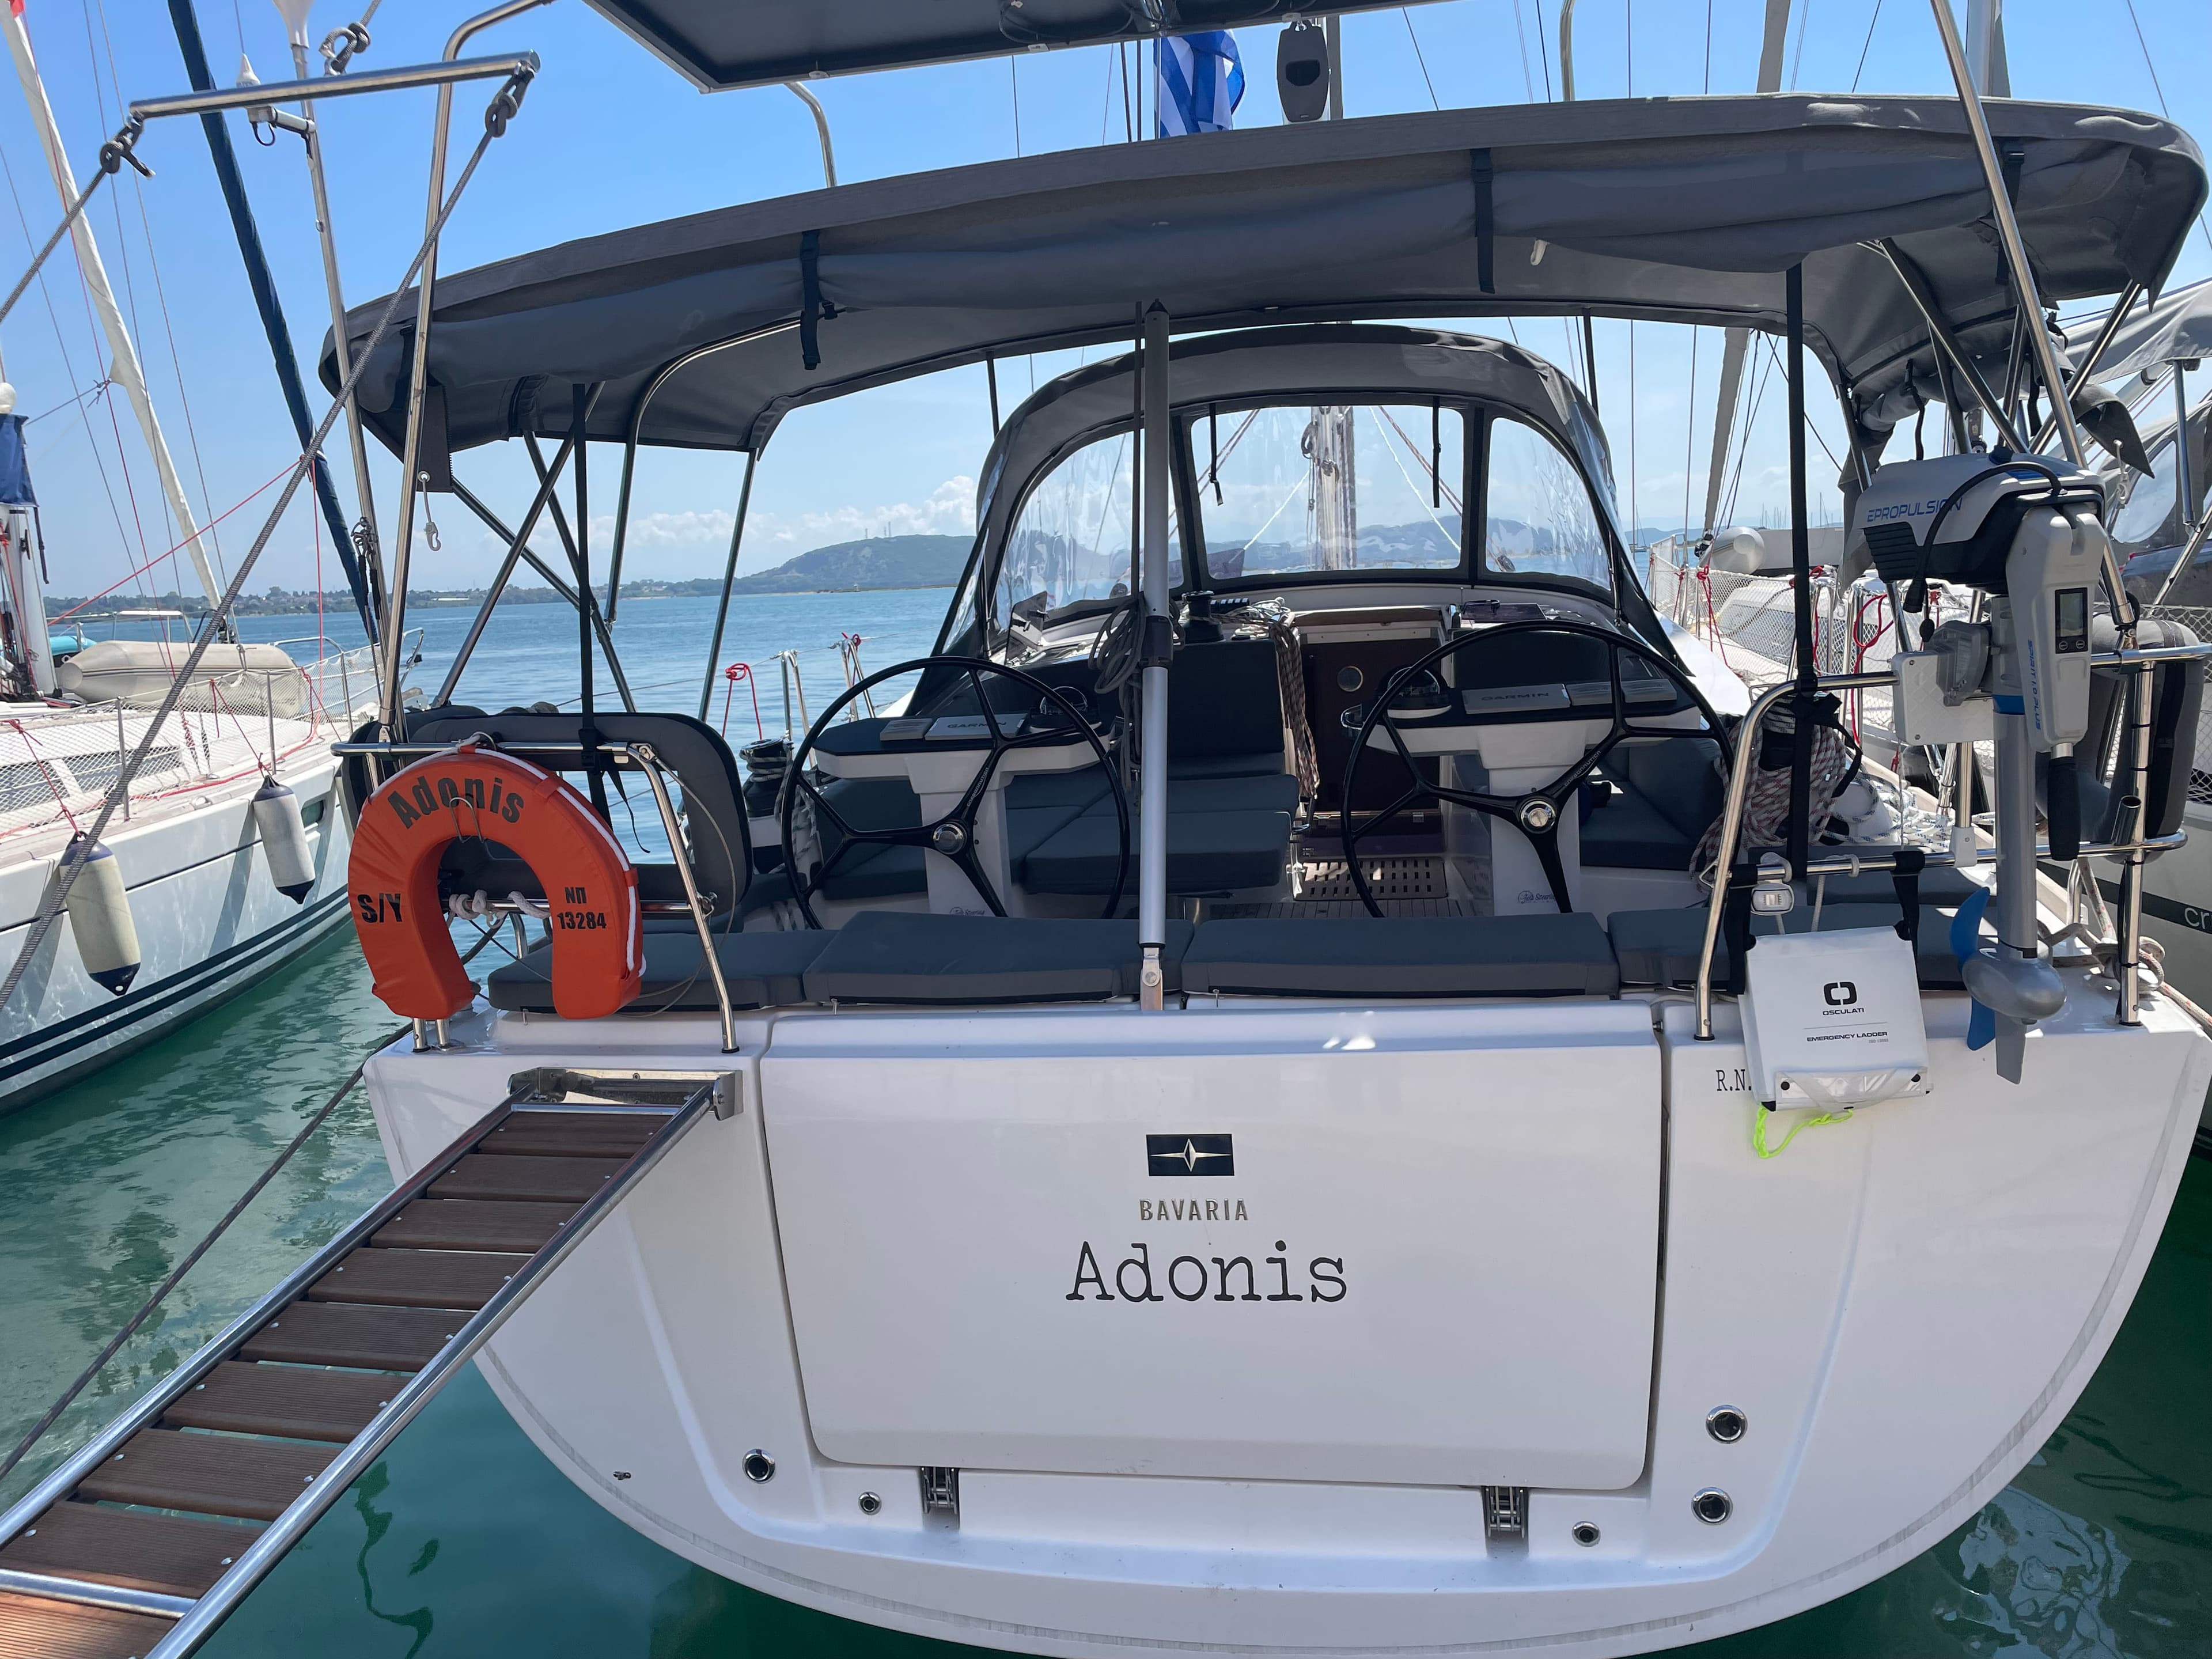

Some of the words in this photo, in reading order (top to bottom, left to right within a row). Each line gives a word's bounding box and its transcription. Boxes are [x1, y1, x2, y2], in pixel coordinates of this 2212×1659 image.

[2028, 639, 2037, 679] SPIRIT
[2033, 696, 2041, 731] PLUS
[1480, 692, 1550, 702] GARMIN
[387, 775, 524, 830] Adonis
[357, 893, 403, 923] S/Y
[2184, 907, 2212, 929] cr
[557, 911, 607, 930] 13284
[1823, 1007, 1865, 1016] OSCULATI
[1806, 1033, 1855, 1042] EMERGENCY
[1715, 1069, 1752, 1092] R.N.
[1139, 1198, 1249, 1221] BAVARIA
[1065, 1240, 1347, 1303] Adonis
